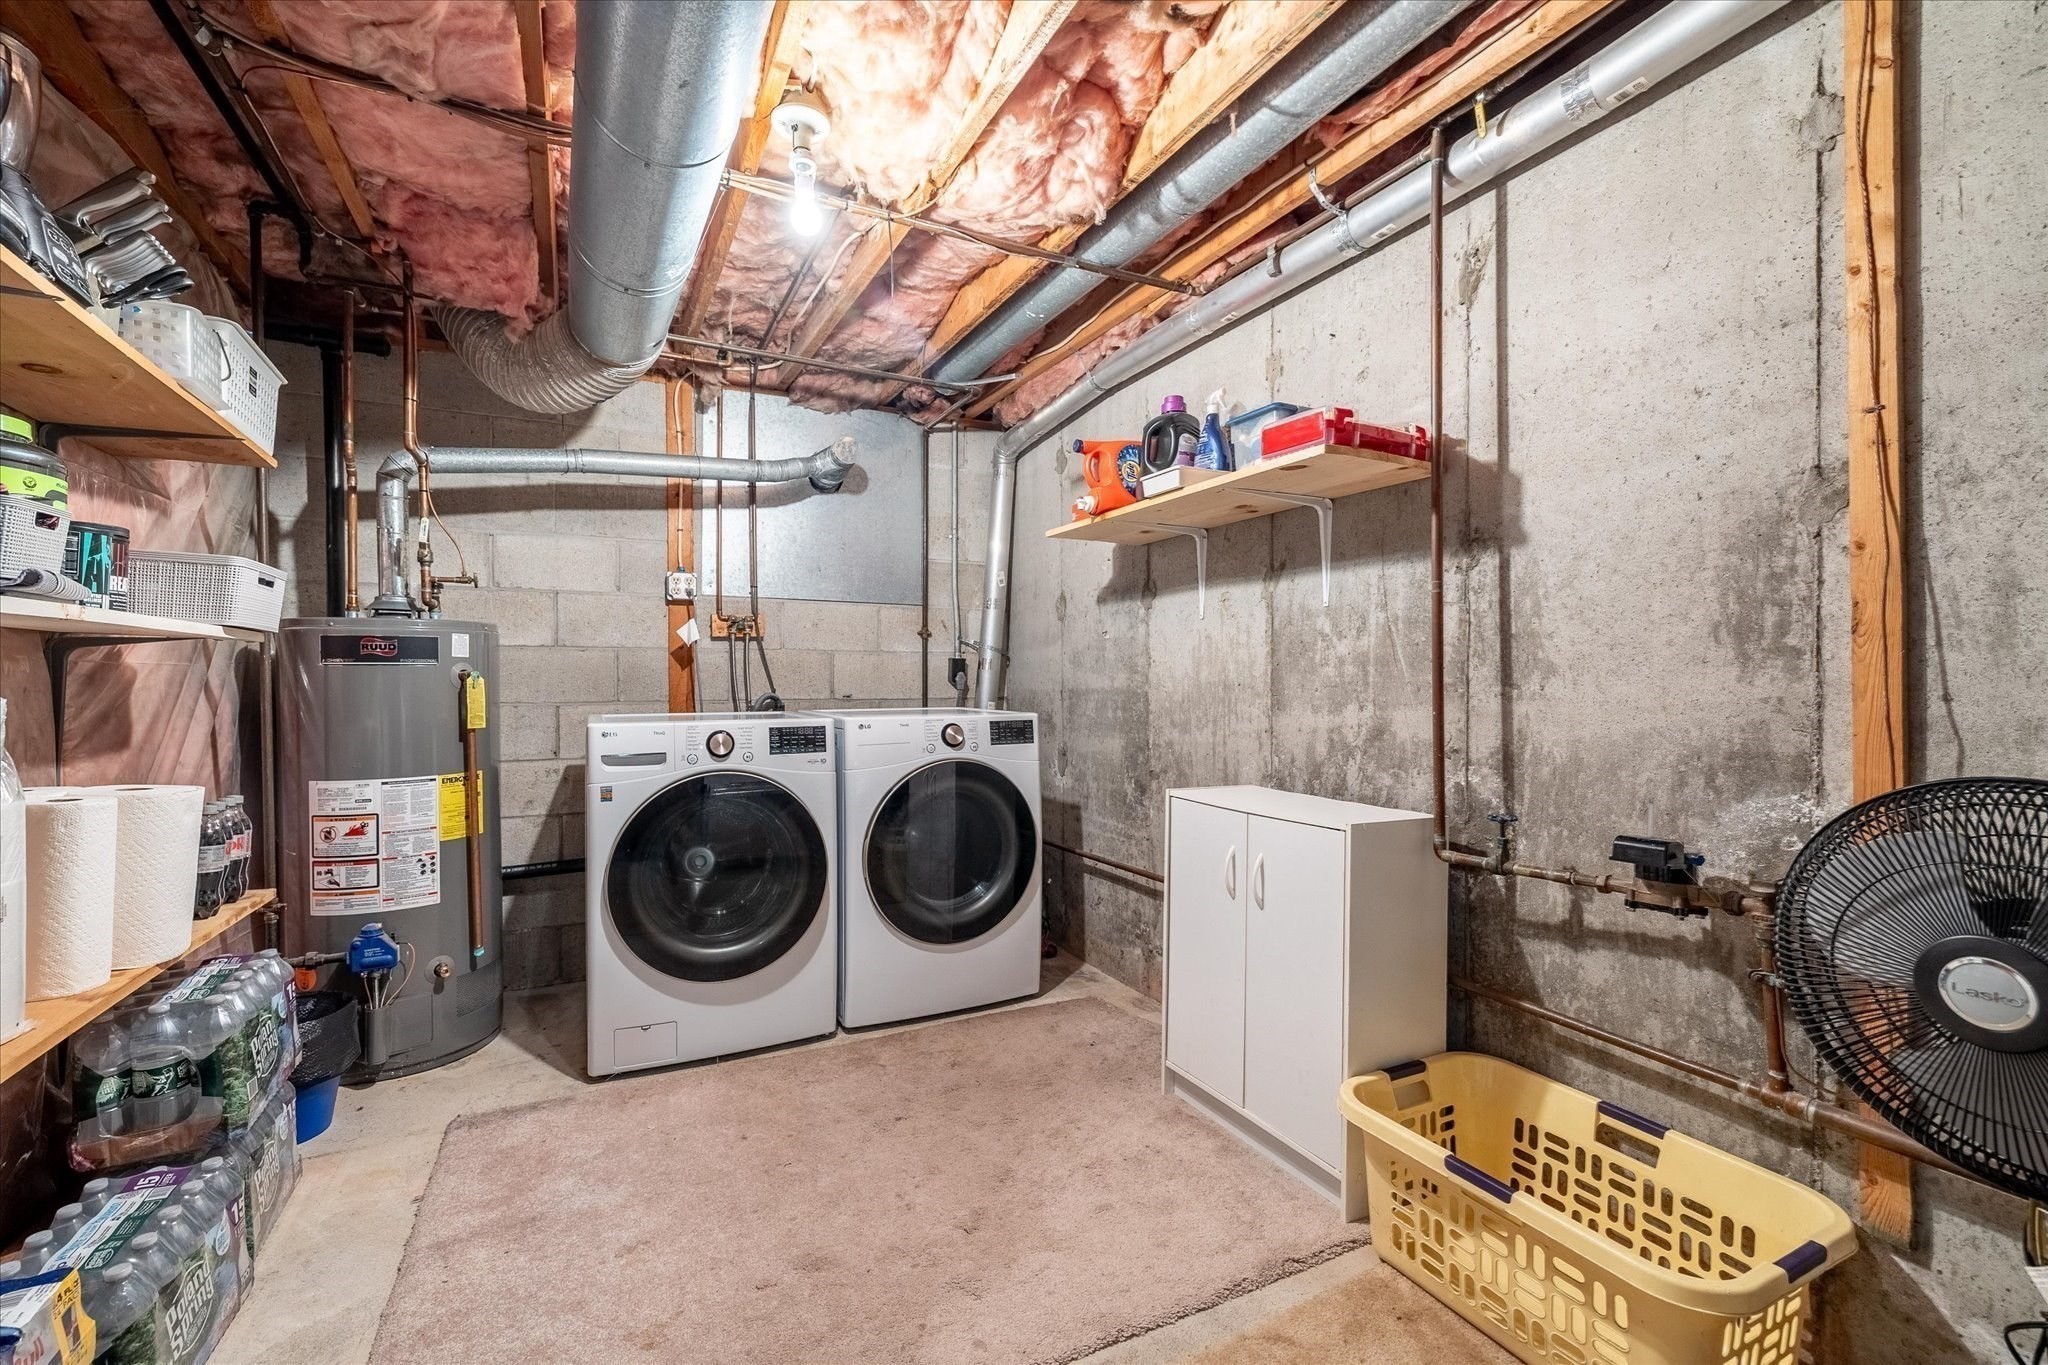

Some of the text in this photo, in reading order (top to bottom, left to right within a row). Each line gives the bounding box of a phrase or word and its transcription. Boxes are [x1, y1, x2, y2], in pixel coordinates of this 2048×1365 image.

[1126, 462, 1136, 480] Tide
[361, 643, 397, 651] RUUD
[1951, 981, 2026, 1009] Lasko
[133, 1174, 161, 1190] 15
[231, 1195, 246, 1224] 15
[164, 1259, 212, 1340] Poland
[170, 1273, 215, 1362] Spring
